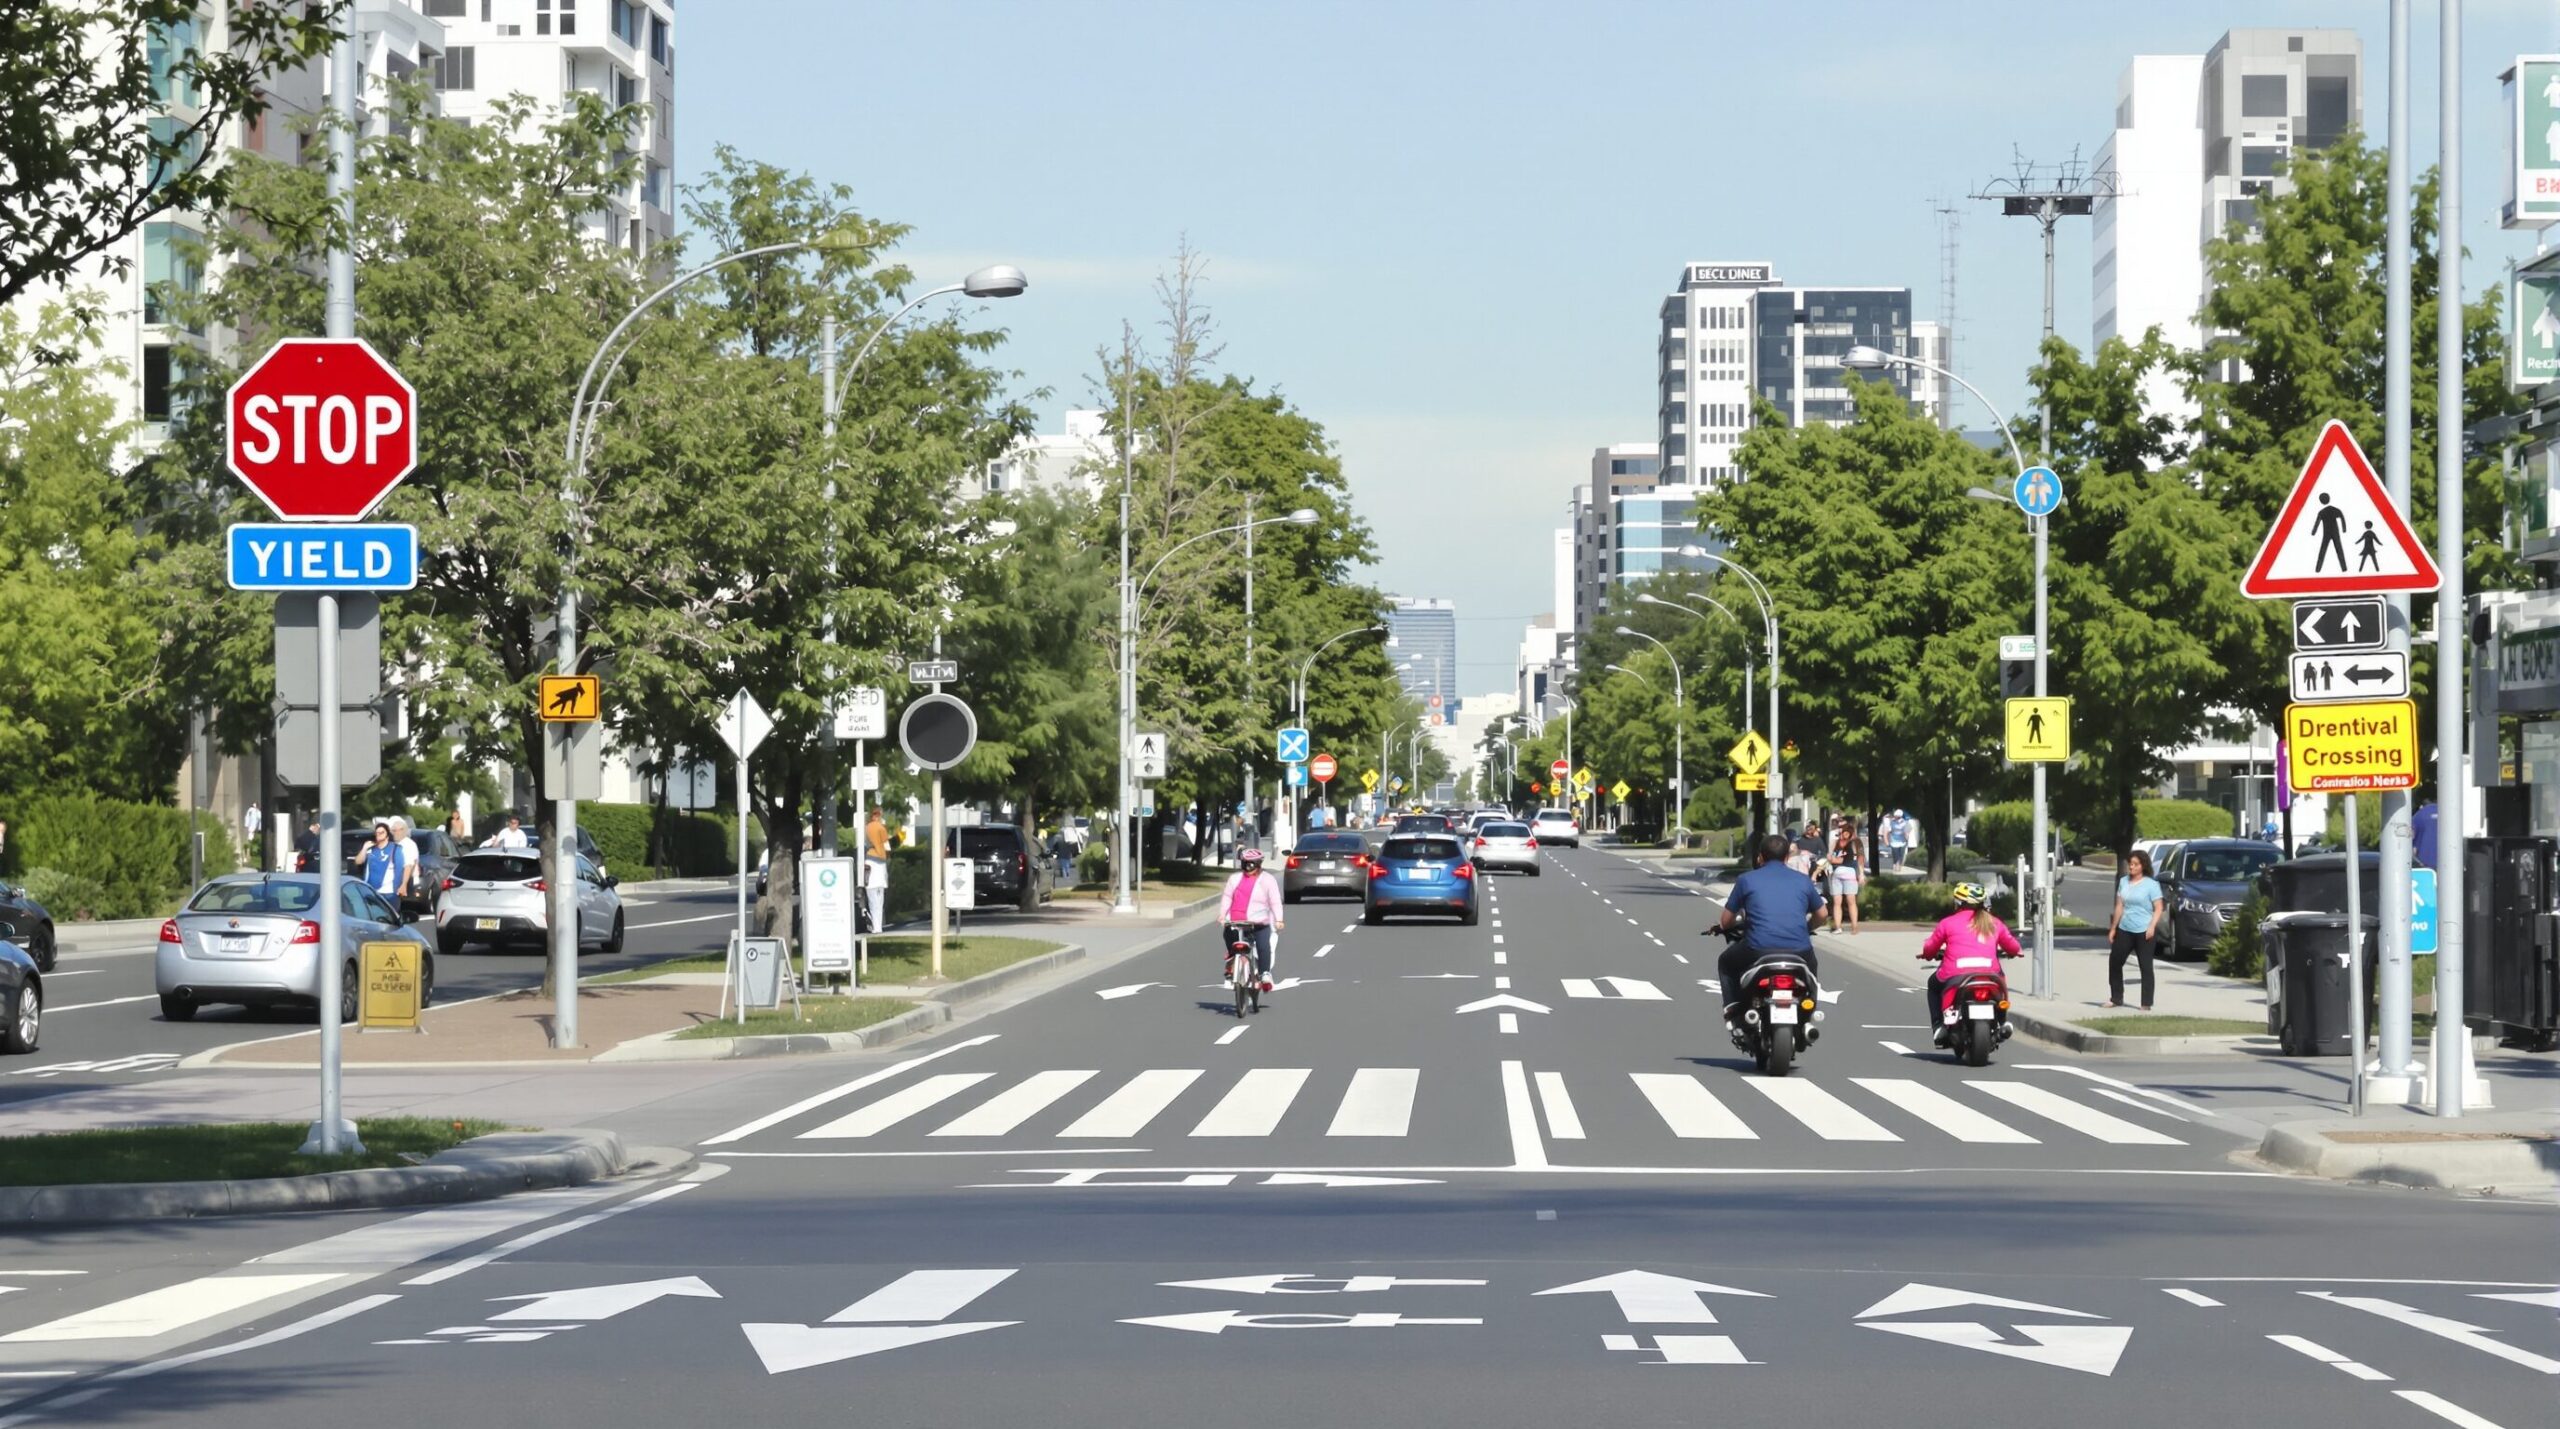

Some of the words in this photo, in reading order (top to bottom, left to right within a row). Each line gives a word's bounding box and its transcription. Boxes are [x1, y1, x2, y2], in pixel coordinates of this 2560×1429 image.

[241, 394, 403, 465] STOP
[248, 541, 393, 578] YIELD
[2299, 716, 2398, 738] Drentival
[2303, 746, 2402, 767] Crossing
